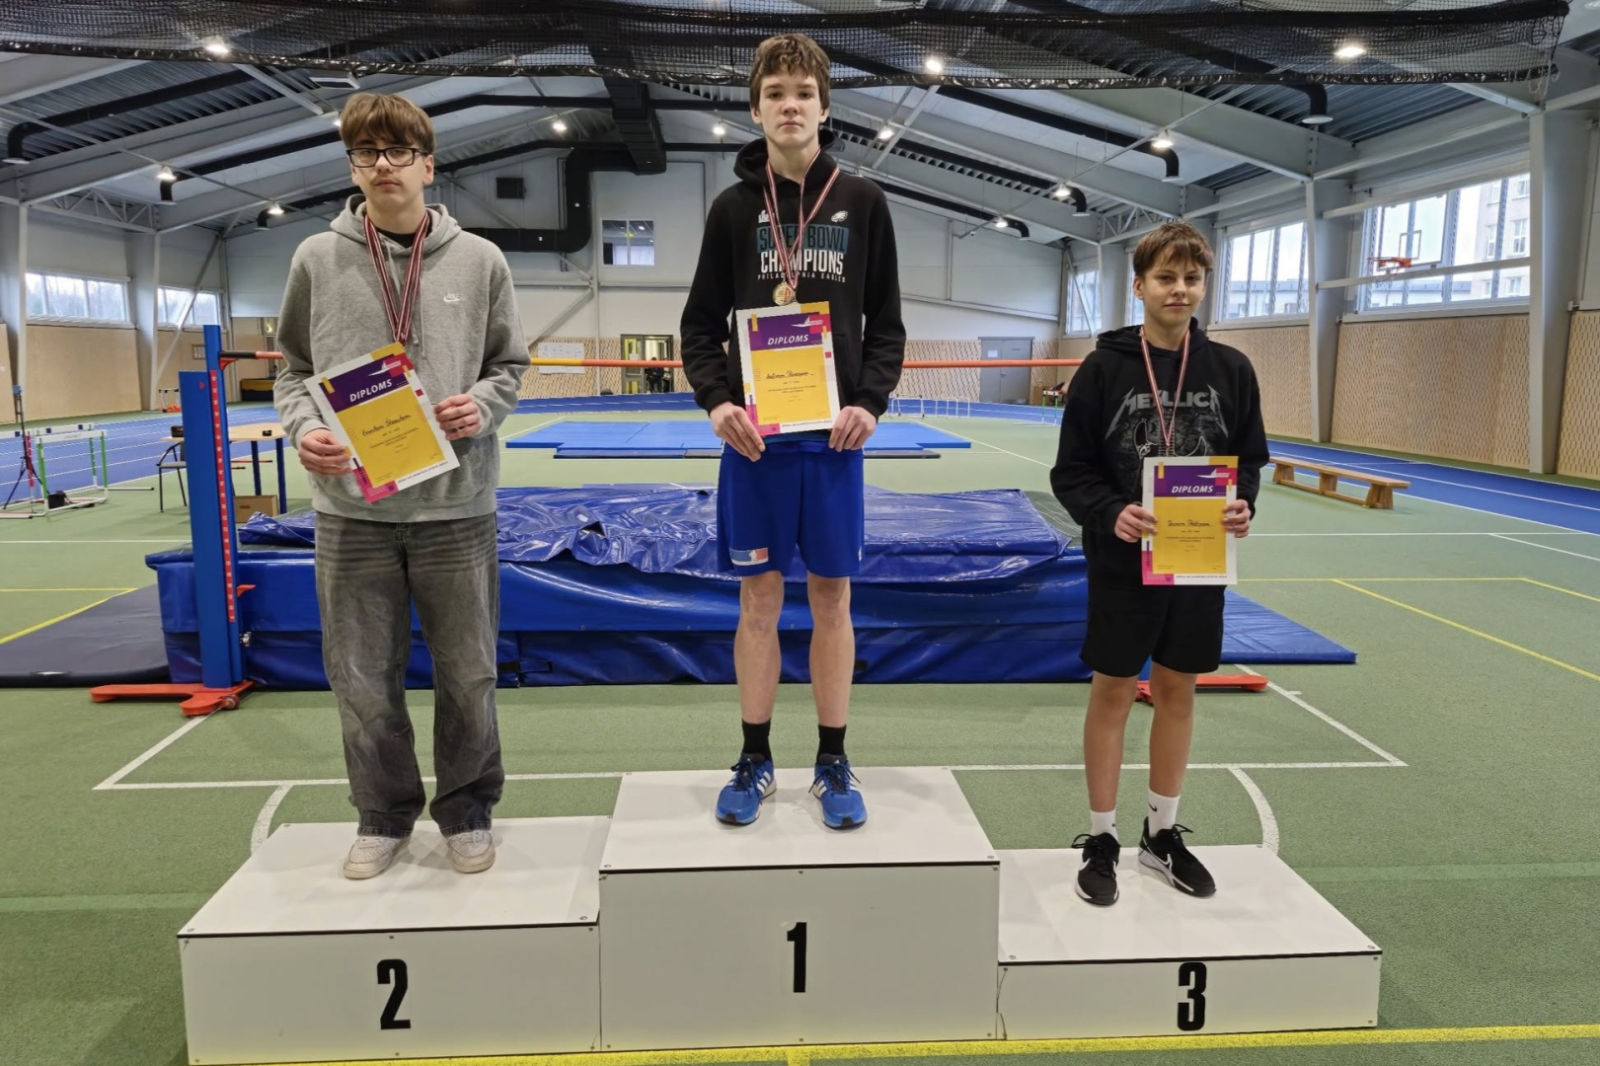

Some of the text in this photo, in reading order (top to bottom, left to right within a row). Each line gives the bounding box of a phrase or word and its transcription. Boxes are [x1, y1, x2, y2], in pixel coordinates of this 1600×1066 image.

[760, 226, 845, 252] SUE BOWL
[760, 249, 844, 275] CHMPIONS
[767, 334, 809, 346] DIPLOMS
[349, 378, 393, 403] DIPLOMS
[1104, 383, 1229, 440] MELLICA
[1171, 485, 1214, 494] DIPLOMS
[787, 922, 807, 993] 1
[377, 959, 411, 1030] 2
[1177, 961, 1207, 1031] 3
